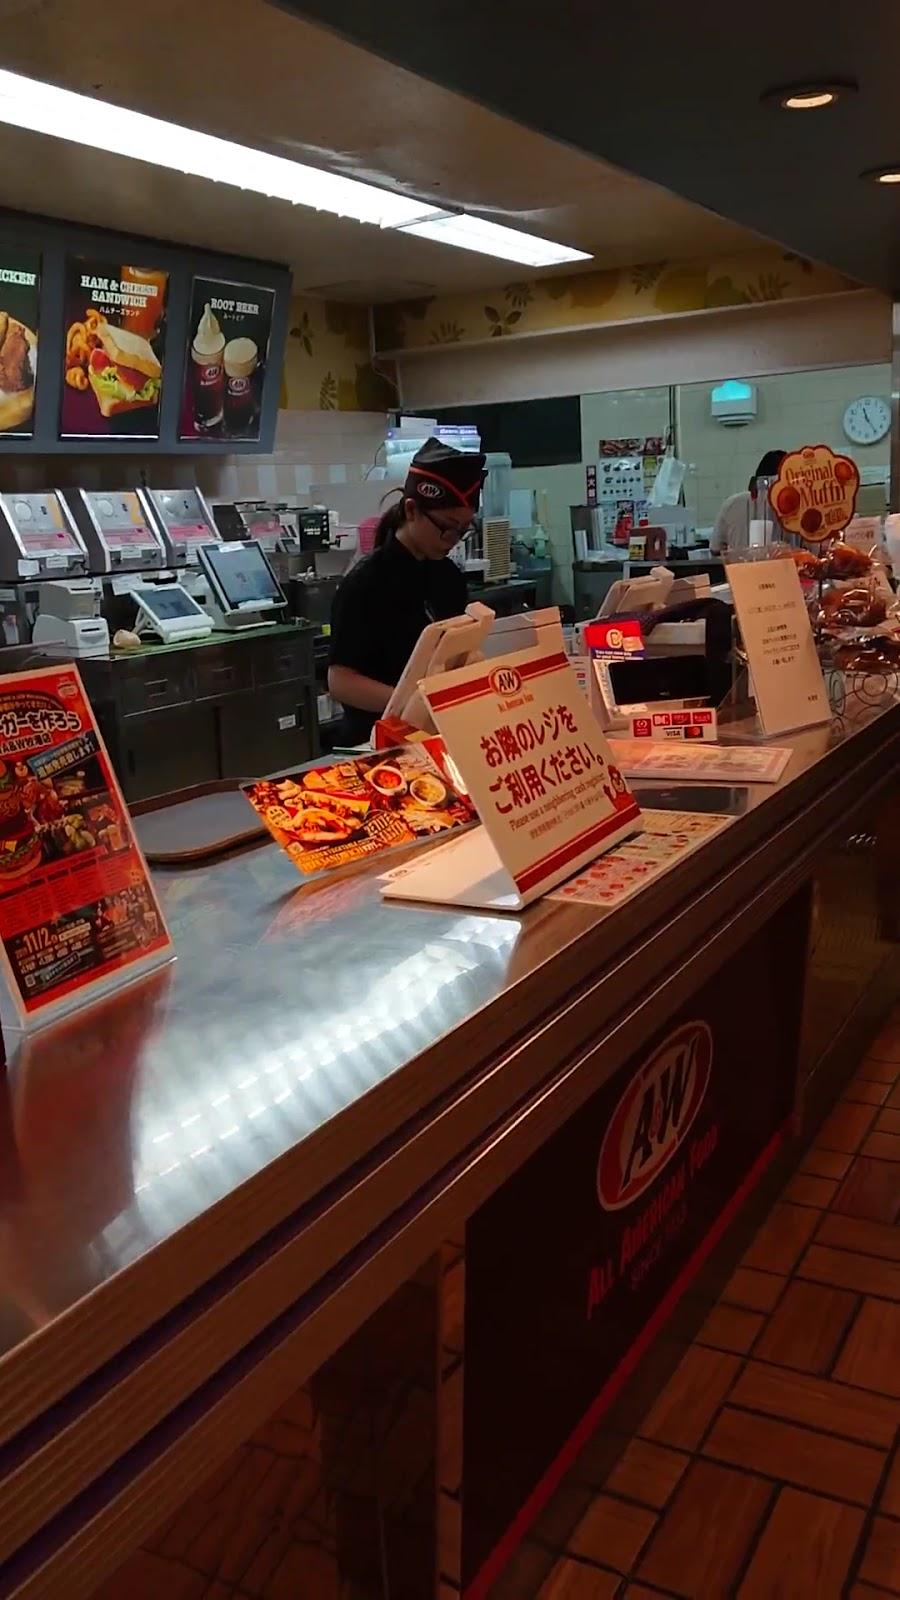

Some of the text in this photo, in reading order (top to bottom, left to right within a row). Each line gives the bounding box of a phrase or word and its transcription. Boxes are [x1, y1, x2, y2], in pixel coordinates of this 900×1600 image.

[80, 275, 158, 297] HAM & CHEESE
[91, 290, 148, 308] SANDWICH
[210, 298, 259, 315] ROOT BEER
[785, 460, 833, 487] Original
[800, 480, 846, 506] Muffin
[0, 710, 81, 737] ガーを作ろう
[480, 704, 577, 768] お隣のレジを
[489, 743, 604, 814] ご利用ください。
[508, 815, 529, 832] Please
